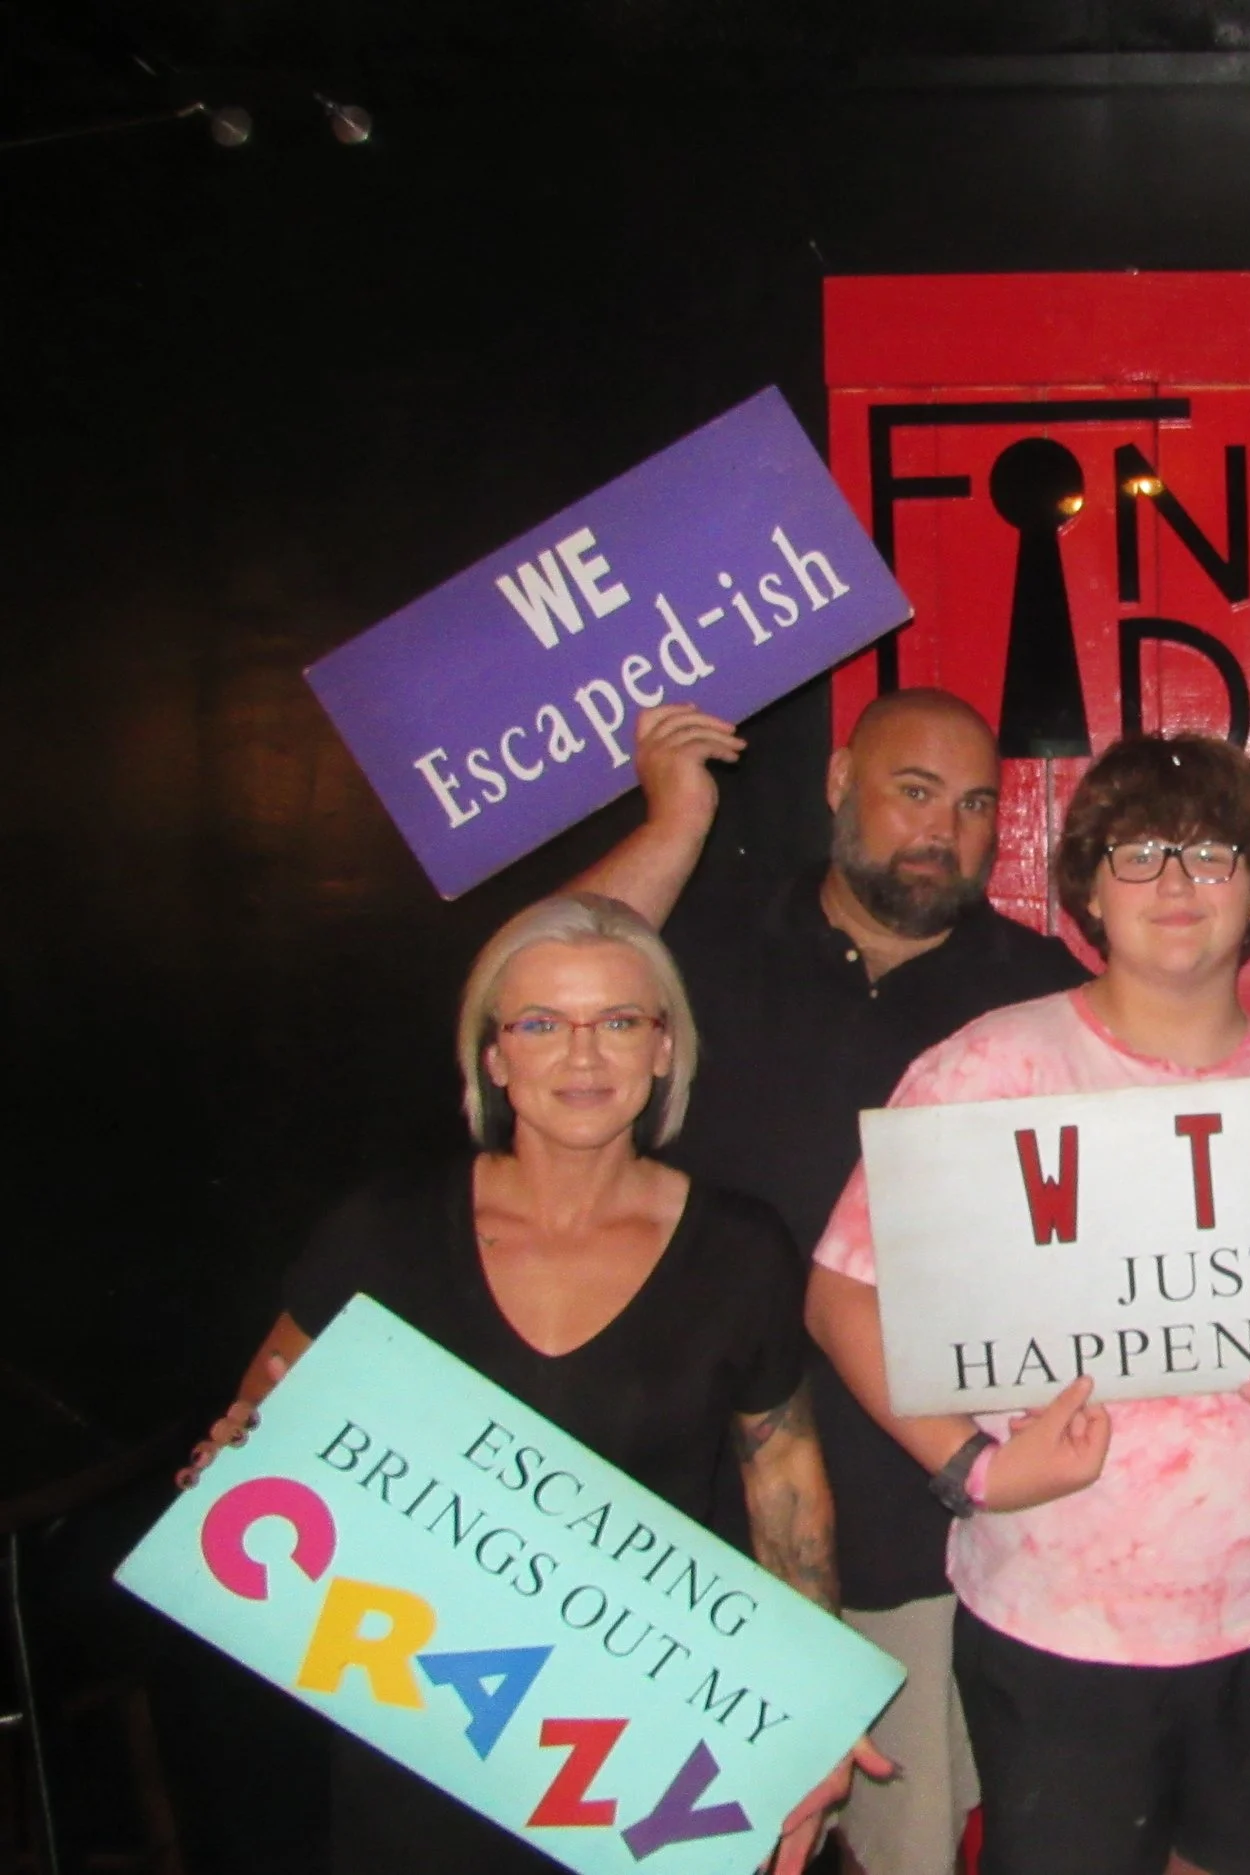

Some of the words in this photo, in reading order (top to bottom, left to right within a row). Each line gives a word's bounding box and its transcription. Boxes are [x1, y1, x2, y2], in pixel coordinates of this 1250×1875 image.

[413, 526, 850, 829] Escaped-ish
[495, 527, 631, 649] WE
[200, 1475, 754, 1862] CRAZY
[316, 1419, 558, 1598] BRINGS
[560, 1583, 691, 1683] OUT
[686, 1665, 793, 1746] MY
[463, 1418, 759, 1638] ESCAPING
